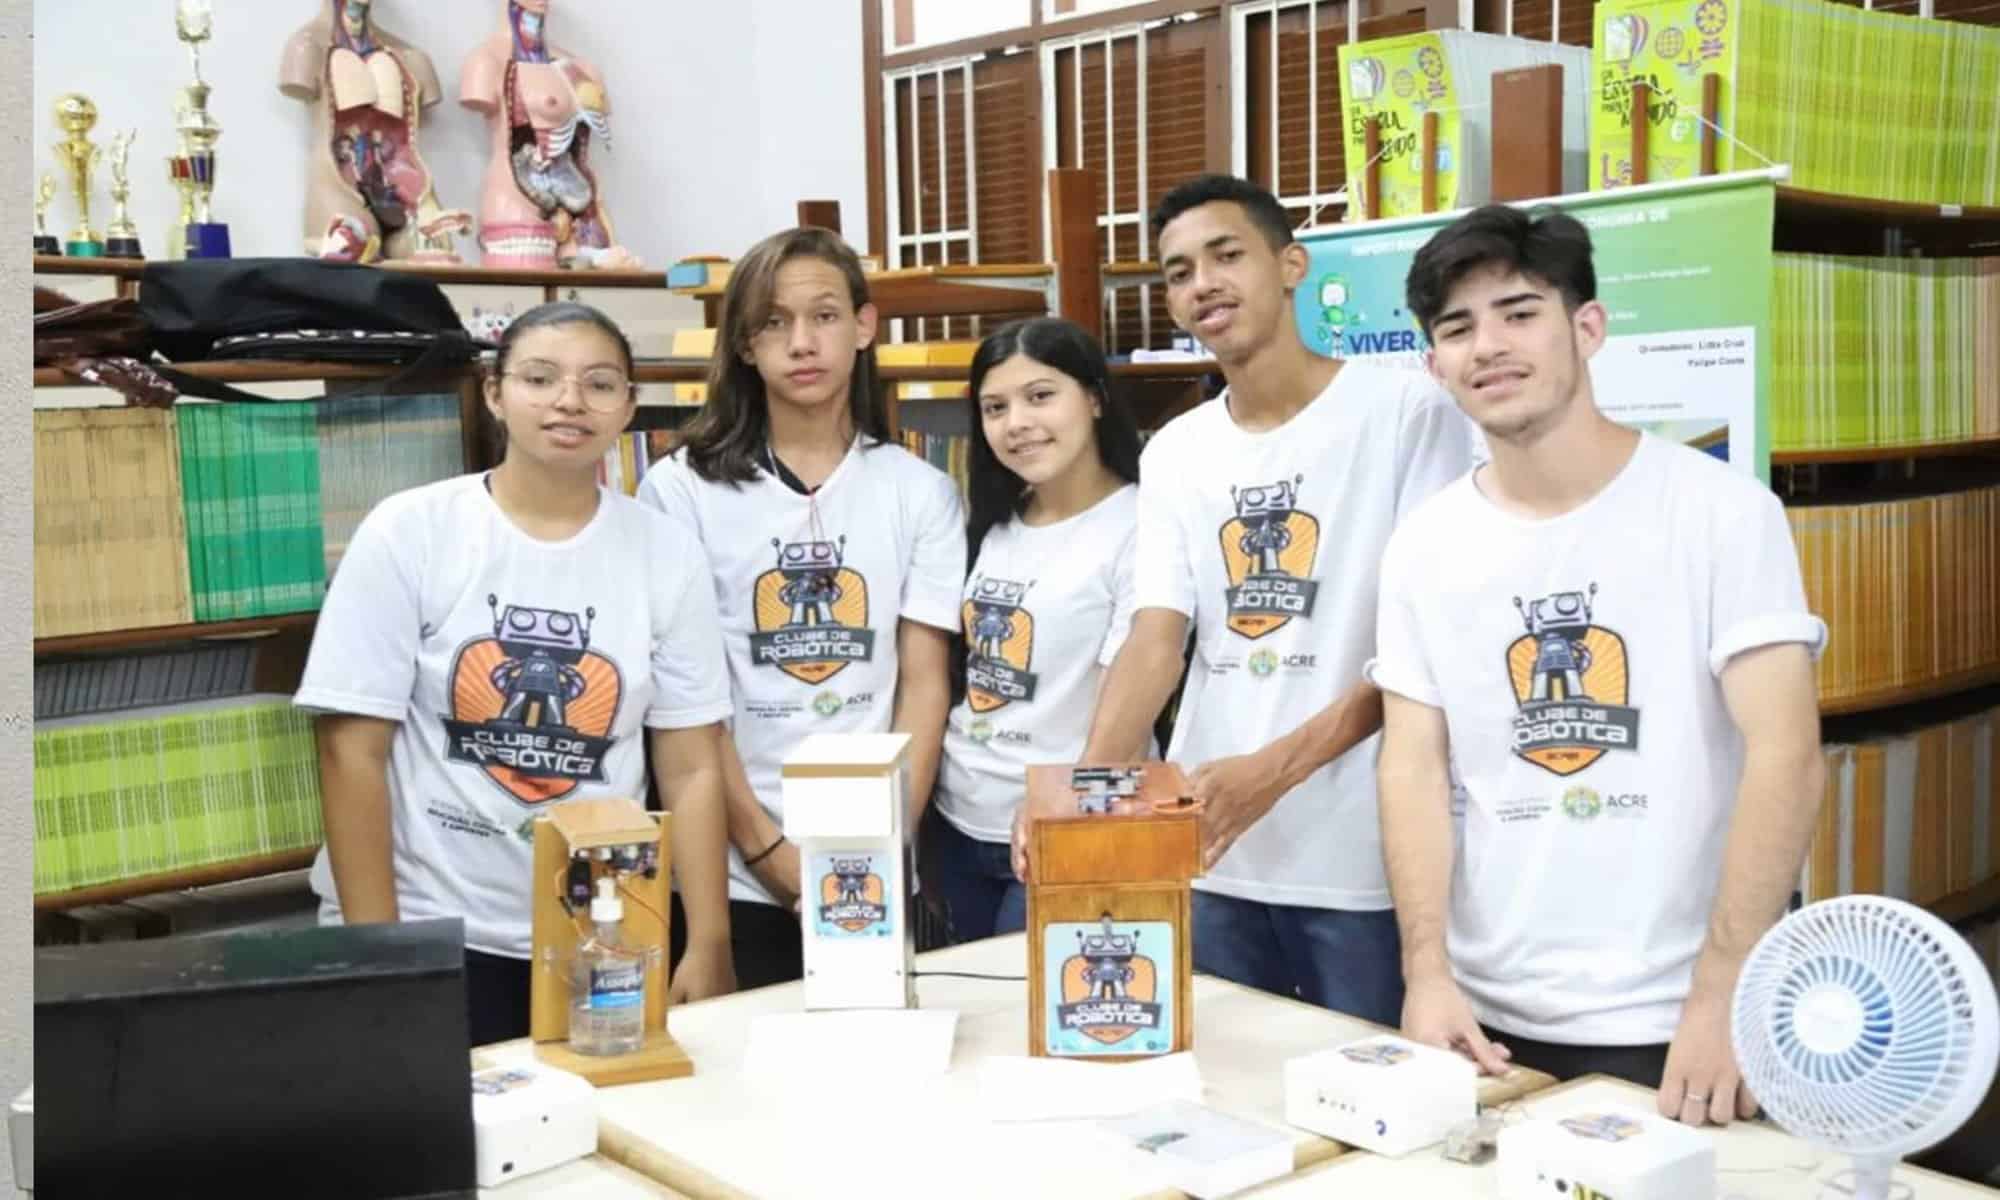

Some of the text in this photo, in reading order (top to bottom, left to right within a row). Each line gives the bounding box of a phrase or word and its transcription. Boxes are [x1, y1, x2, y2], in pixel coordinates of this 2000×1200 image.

[1349, 330, 1416, 354] VIVER
[773, 630, 827, 645] CLUBE
[1581, 707, 1607, 722] DE
[474, 731, 587, 755] CLUBE DE
[1607, 794, 1649, 809] ACRE
